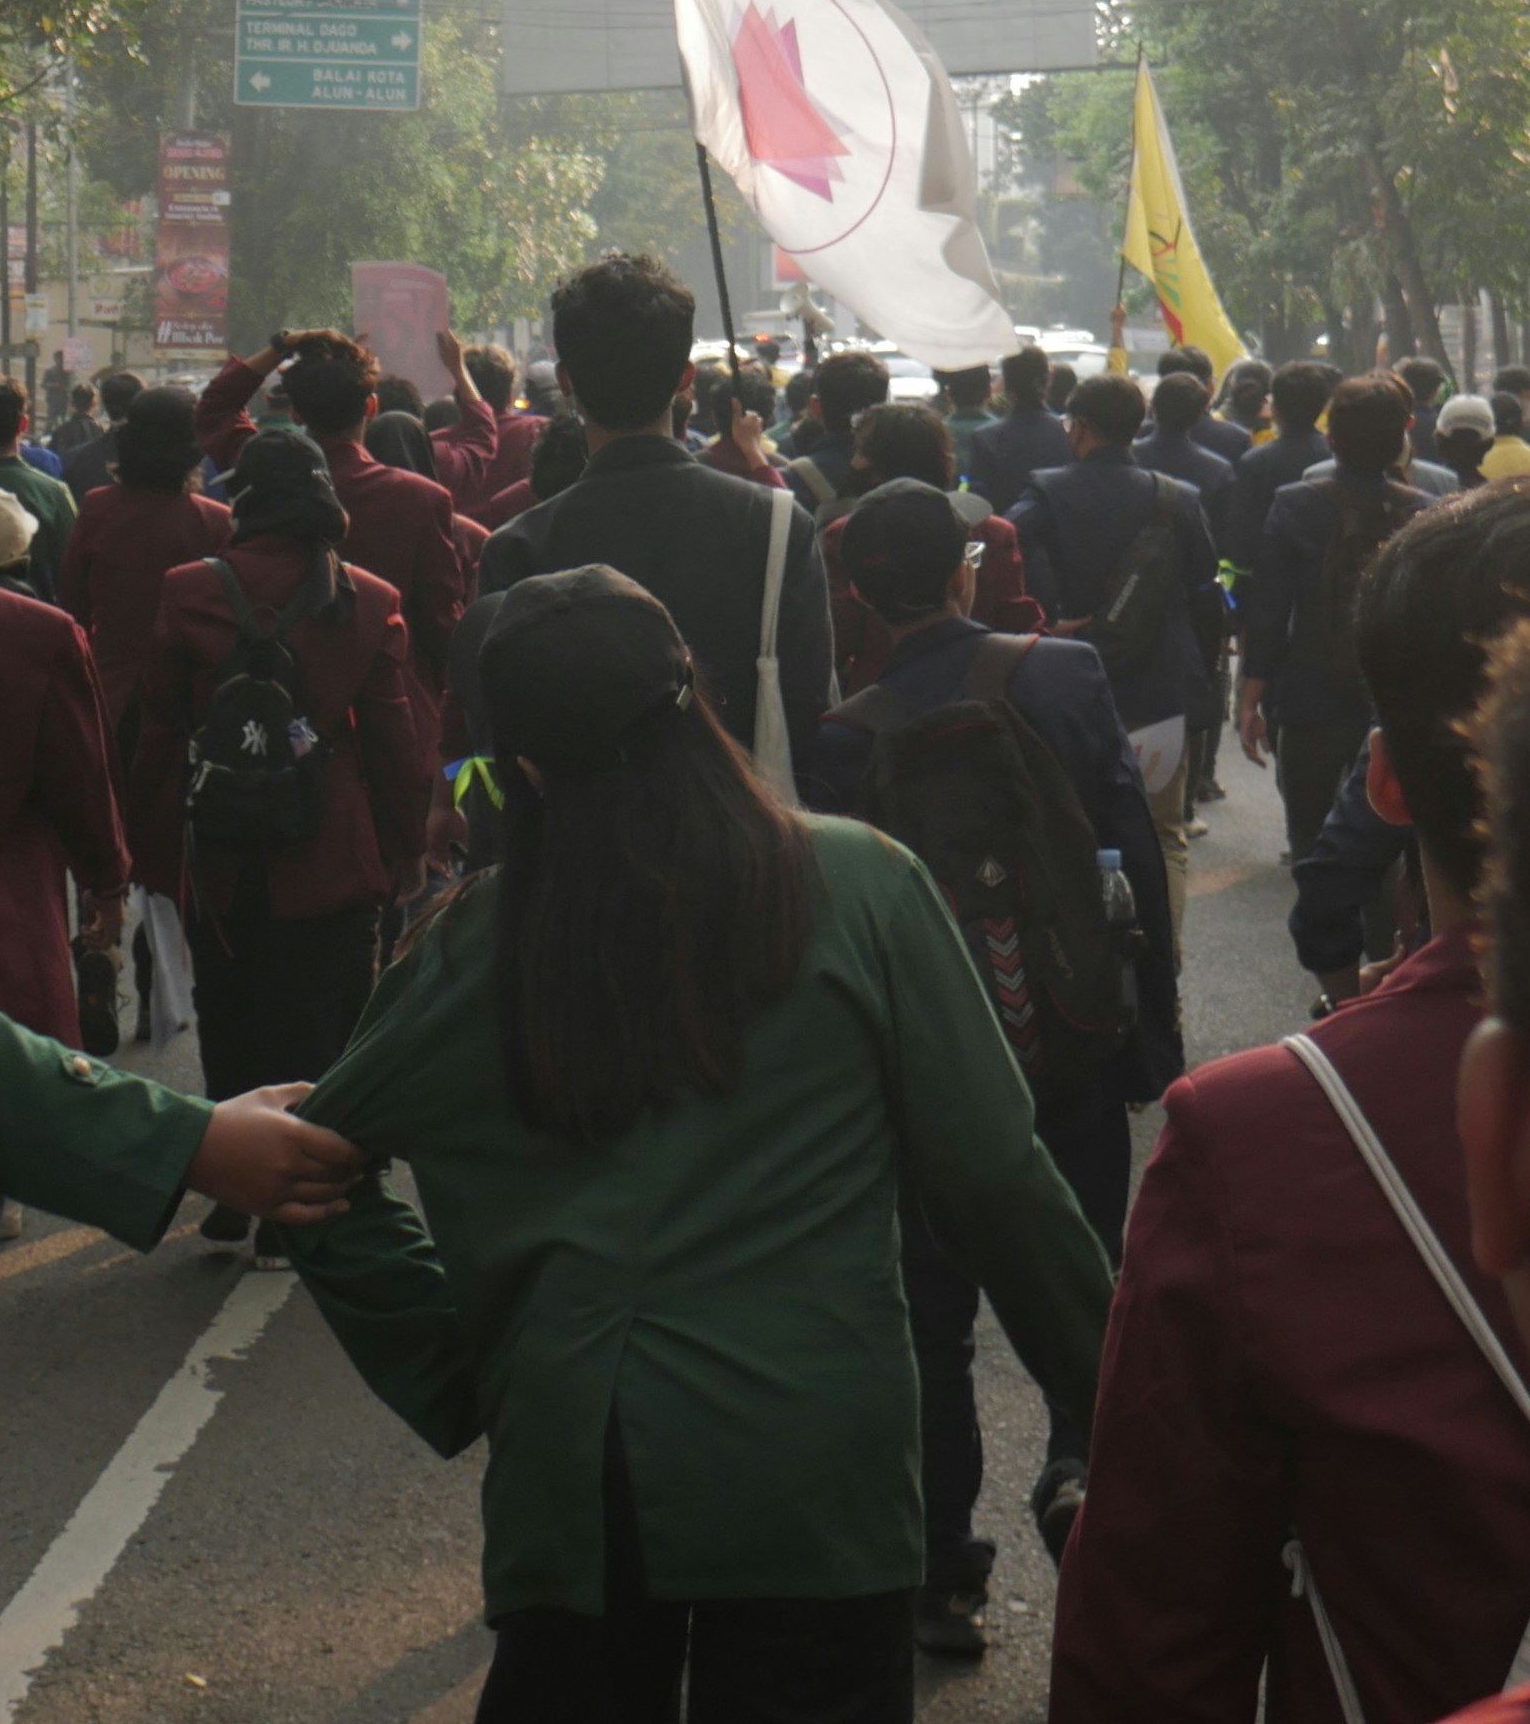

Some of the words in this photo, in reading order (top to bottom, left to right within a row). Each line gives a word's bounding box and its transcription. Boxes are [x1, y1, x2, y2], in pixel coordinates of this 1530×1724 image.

[246, 21, 314, 36] TERMINAL
[320, 23, 357, 37] DAGO
[313, 40, 377, 55] DJUANDA
[313, 69, 361, 82] BALAI
[367, 70, 405, 83] KOTA
[162, 165, 226, 181] OPENING
